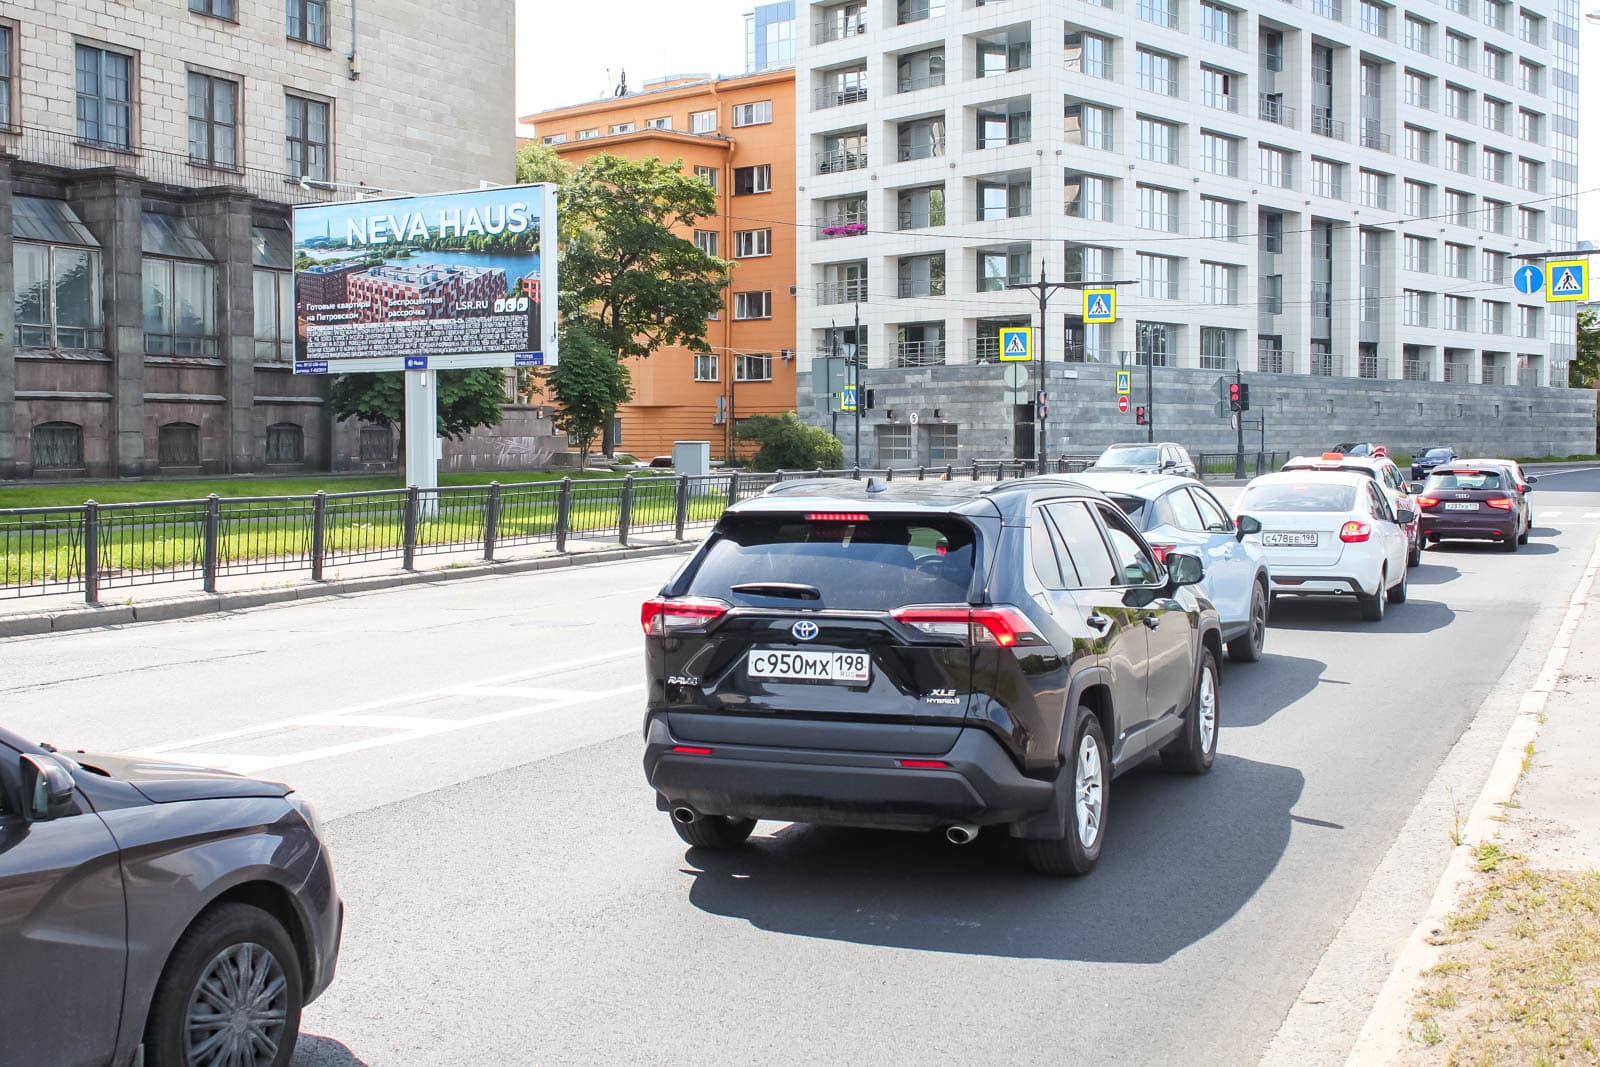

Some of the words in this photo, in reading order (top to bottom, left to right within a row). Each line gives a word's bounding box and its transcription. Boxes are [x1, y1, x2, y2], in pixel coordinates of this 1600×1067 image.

[347, 211, 431, 246] NEVA
[439, 202, 528, 239] HAUS
[306, 303, 335, 312] Готовые
[336, 301, 371, 311] квартиры
[388, 297, 443, 308] Беспроцентная
[455, 300, 489, 311] LSR.RU
[316, 312, 359, 322] Петровском
[388, 308, 426, 318] рассрочка
[835, 655, 864, 671] 198
[930, 689, 957, 697] XLE
